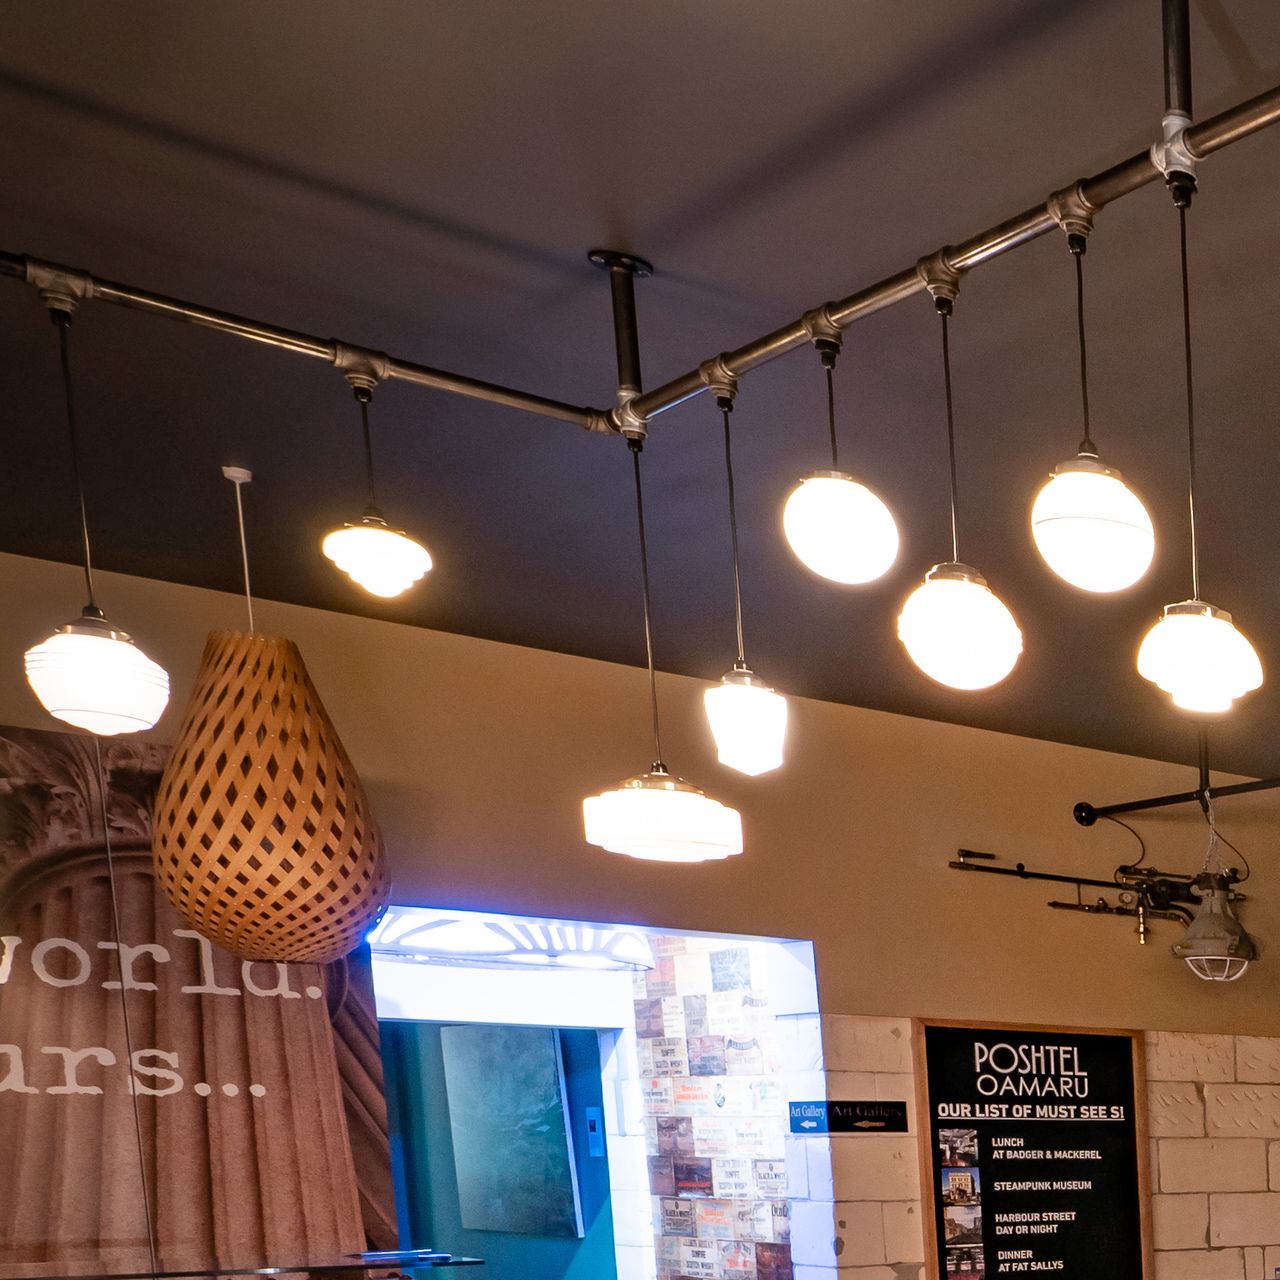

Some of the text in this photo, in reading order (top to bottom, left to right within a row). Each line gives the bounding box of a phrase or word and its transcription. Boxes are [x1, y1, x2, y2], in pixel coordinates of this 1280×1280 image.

[974, 1042, 1088, 1077] POSHTEL
[976, 1074, 1089, 1098] OAMARU
[790, 1104, 825, 1120] Art Gallery
[832, 1104, 903, 1120] Art Gallery
[937, 1103, 971, 1118] OUR
[975, 1103, 1009, 1118] LIST
[1012, 1104, 1032, 1119] OF
[1036, 1104, 1077, 1119] MUST
[1080, 1105, 1108, 1119] SEE
[991, 1137, 1024, 1147] LUNCH
[992, 1150, 1102, 1159] AT BADGER & MACKEREL
[993, 1181, 1092, 1191] STEAMPUNK MUSEUM
[995, 1211, 1076, 1222] HARBOUR STREET
[996, 1224, 1058, 1235] DAY OR NIGHT
[998, 1250, 1033, 1260] DINNER
[998, 1261, 1064, 1272] AT FAT SALLYS
